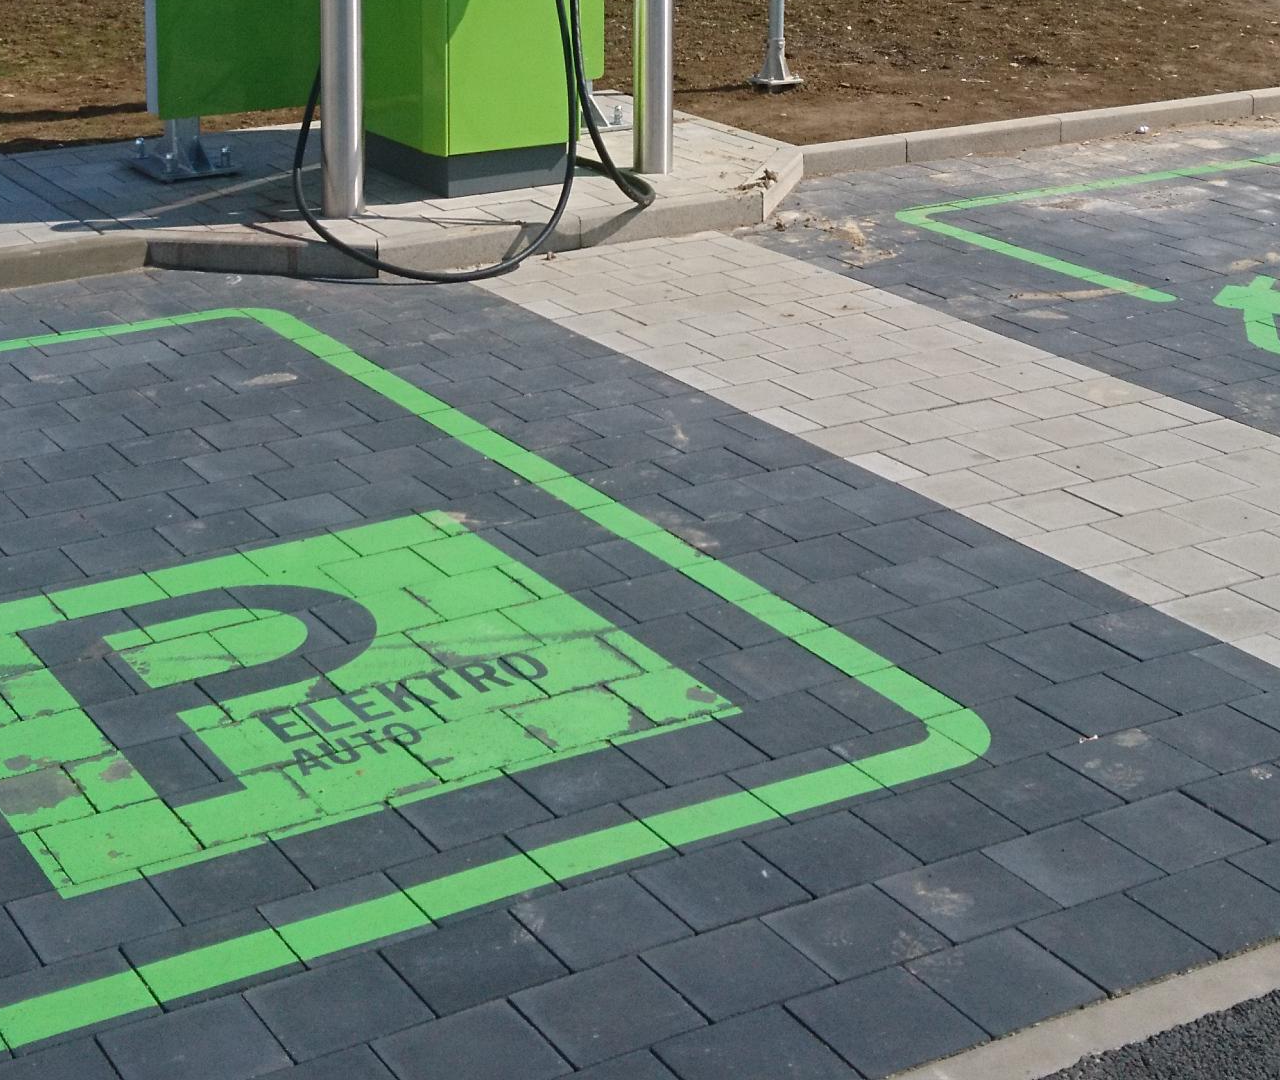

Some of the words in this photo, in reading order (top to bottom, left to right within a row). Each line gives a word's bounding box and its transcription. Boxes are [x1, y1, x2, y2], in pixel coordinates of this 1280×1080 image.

[15, 584, 377, 808] P
[257, 652, 549, 744] ELEKTRO
[292, 722, 423, 777] AUTO
